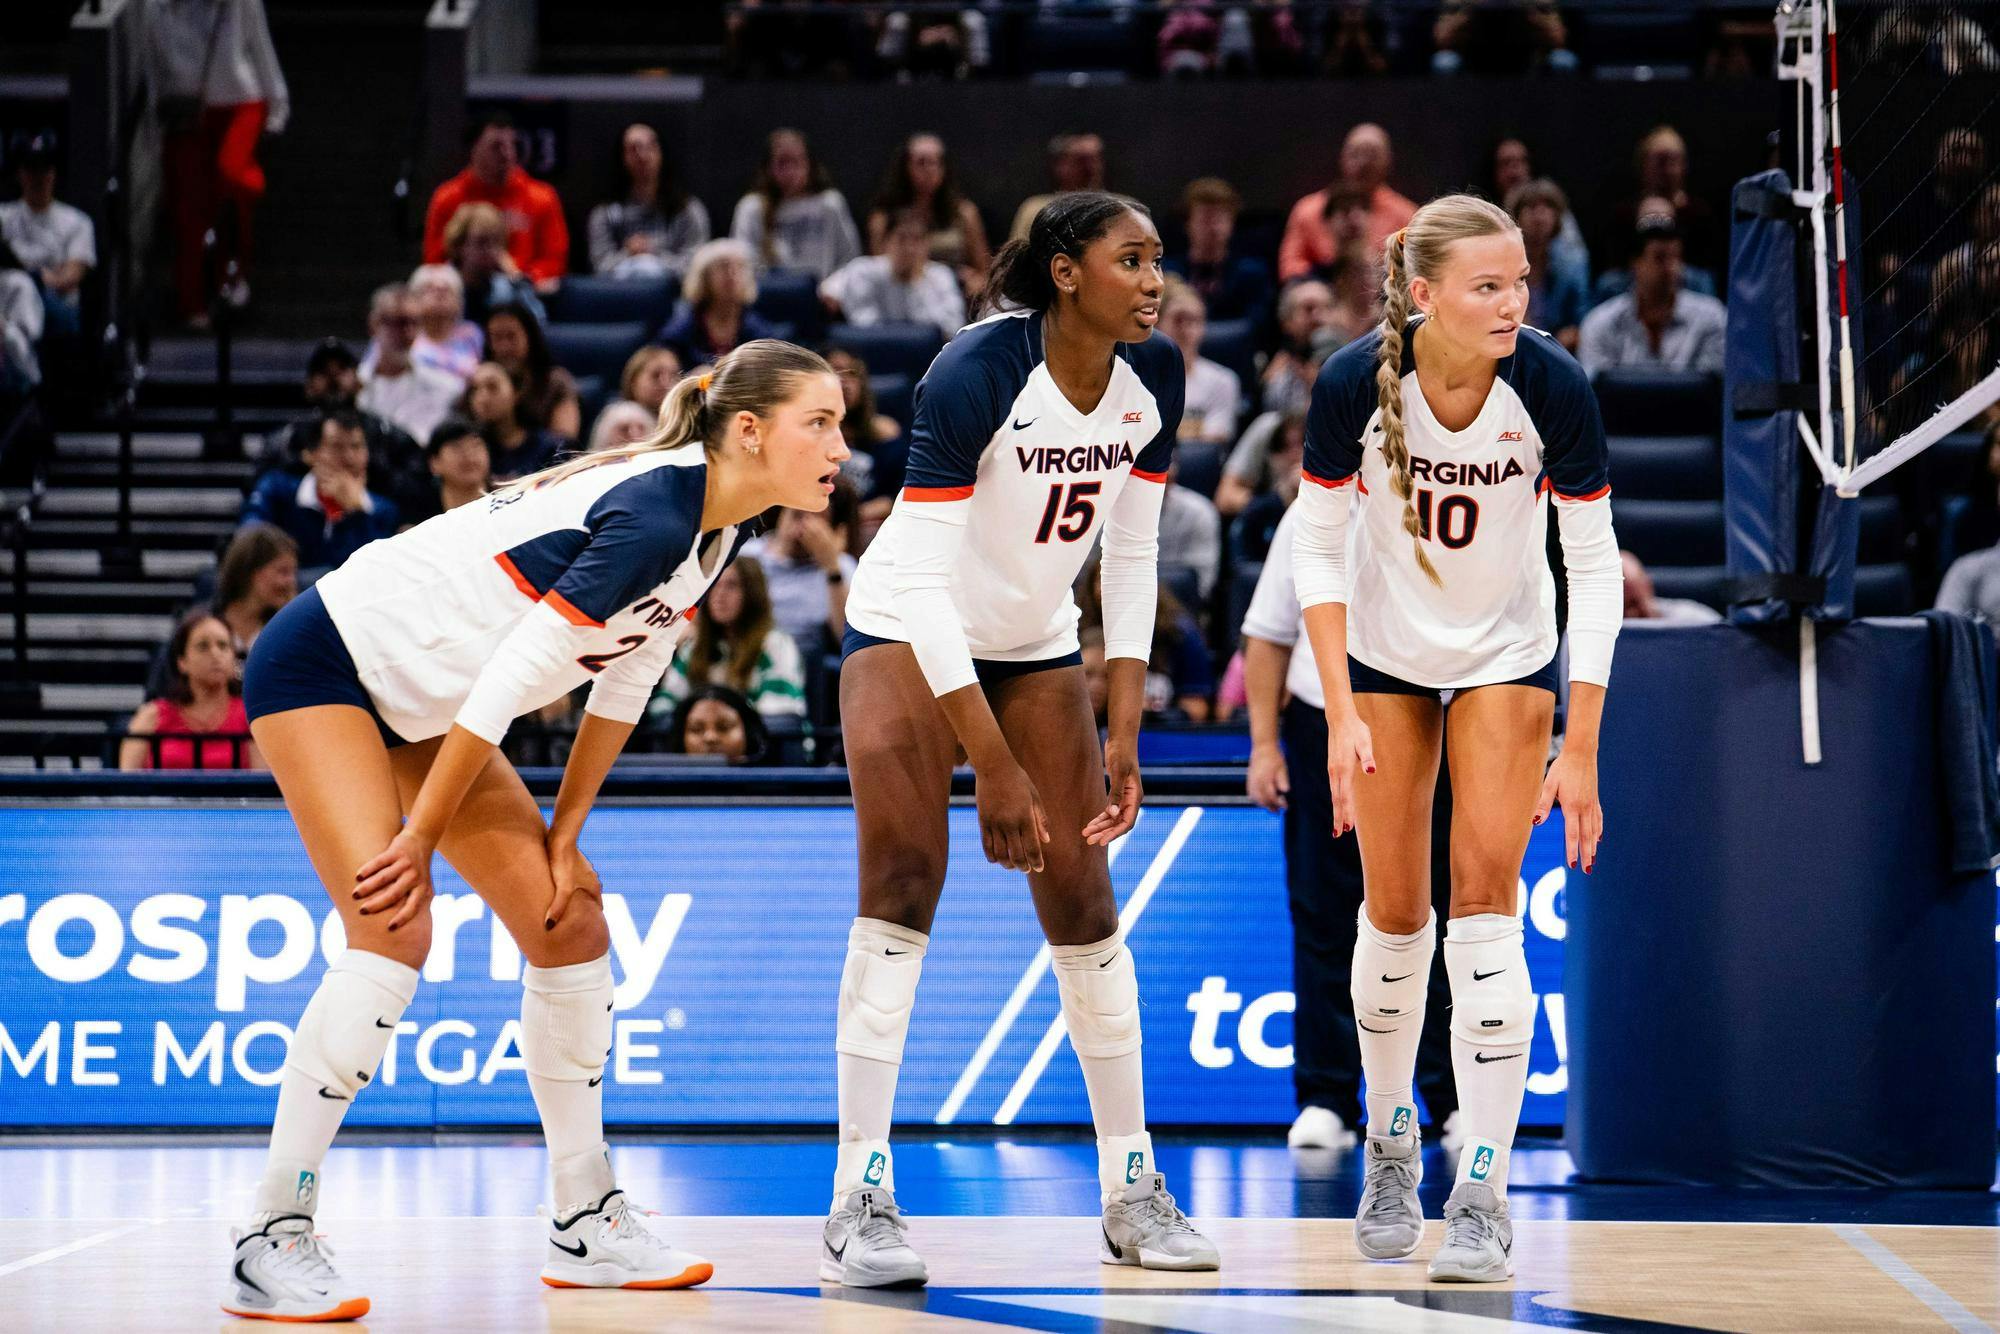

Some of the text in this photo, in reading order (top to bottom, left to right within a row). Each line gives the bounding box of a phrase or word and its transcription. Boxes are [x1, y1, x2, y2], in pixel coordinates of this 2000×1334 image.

[1121, 411, 1143, 422] ACC
[1016, 440, 1134, 474] VIRGINIA
[1376, 447, 1525, 487] RGINIA
[1034, 481, 1103, 544] 15
[1416, 488, 1480, 550] 10
[576, 634, 649, 674] 2
[152, 1019, 664, 1086] MOTGAE
